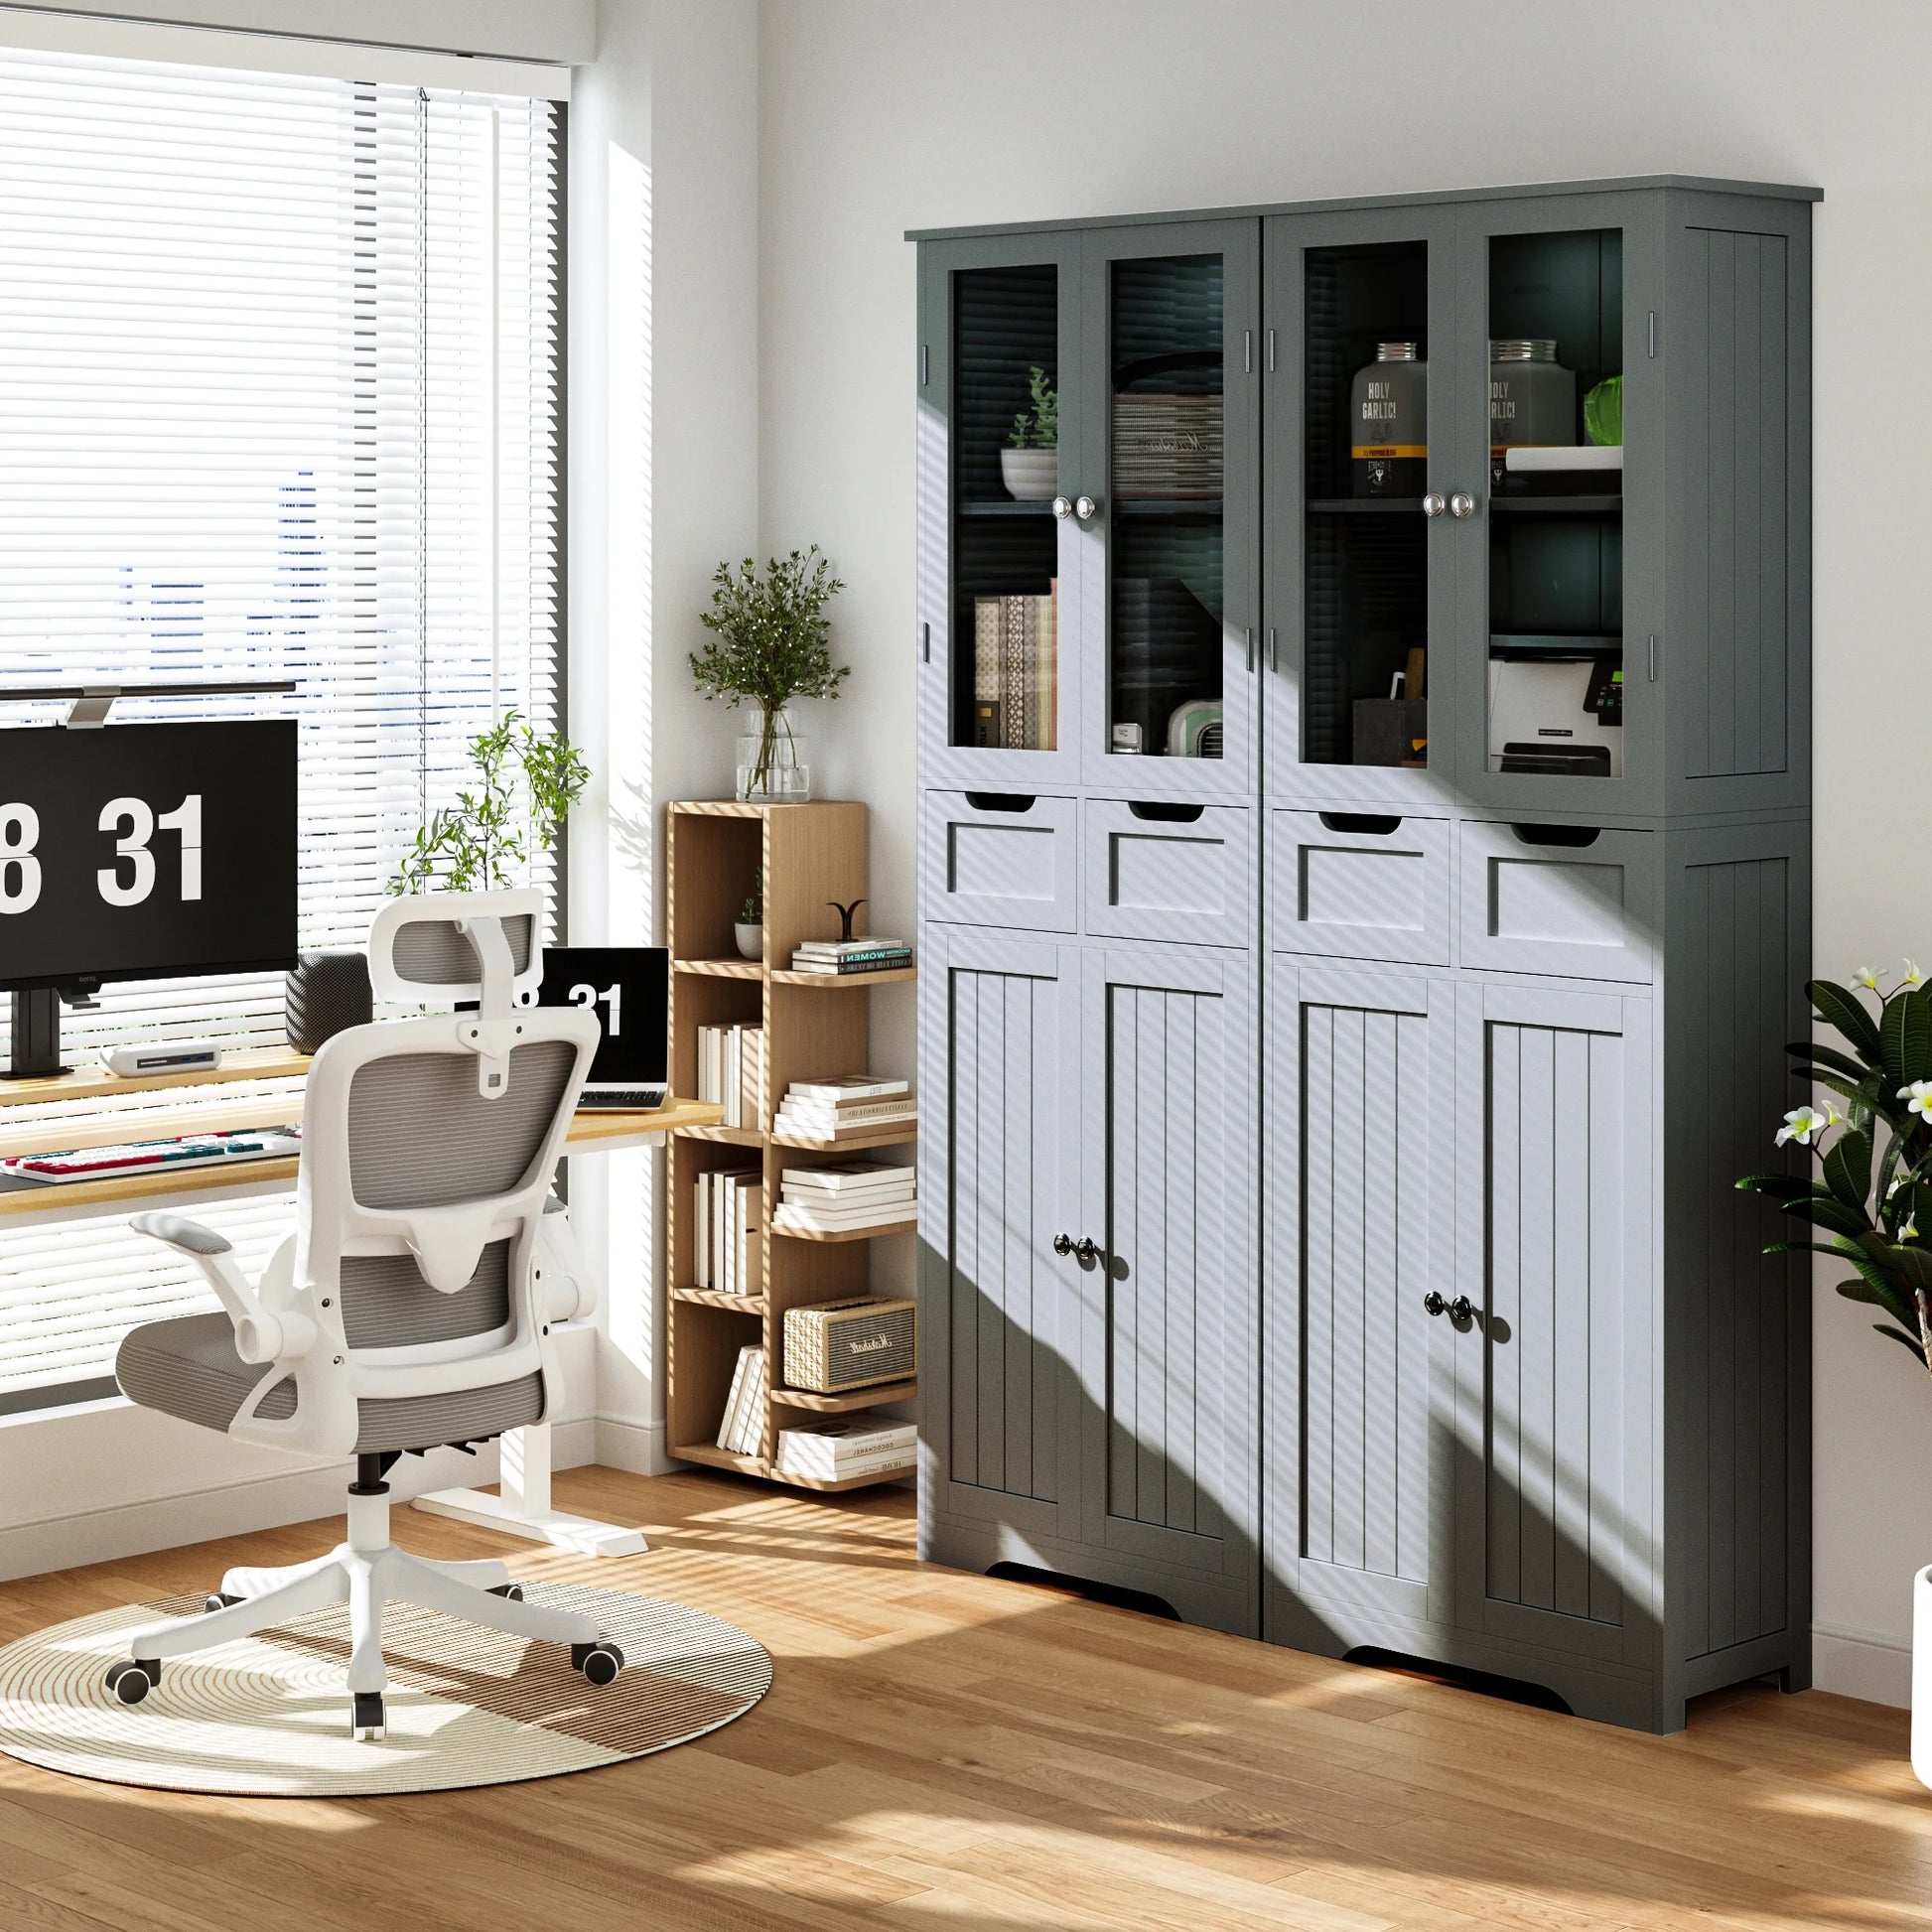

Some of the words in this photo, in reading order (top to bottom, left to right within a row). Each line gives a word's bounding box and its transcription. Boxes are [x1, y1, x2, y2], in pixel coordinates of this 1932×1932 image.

[1368, 382, 1390, 399] HOLY
[1362, 401, 1396, 419] GARLIC!
[1491, 401, 1515, 419] RLIC!
[0, 802, 42, 914] 8
[97, 794, 202, 907] 31
